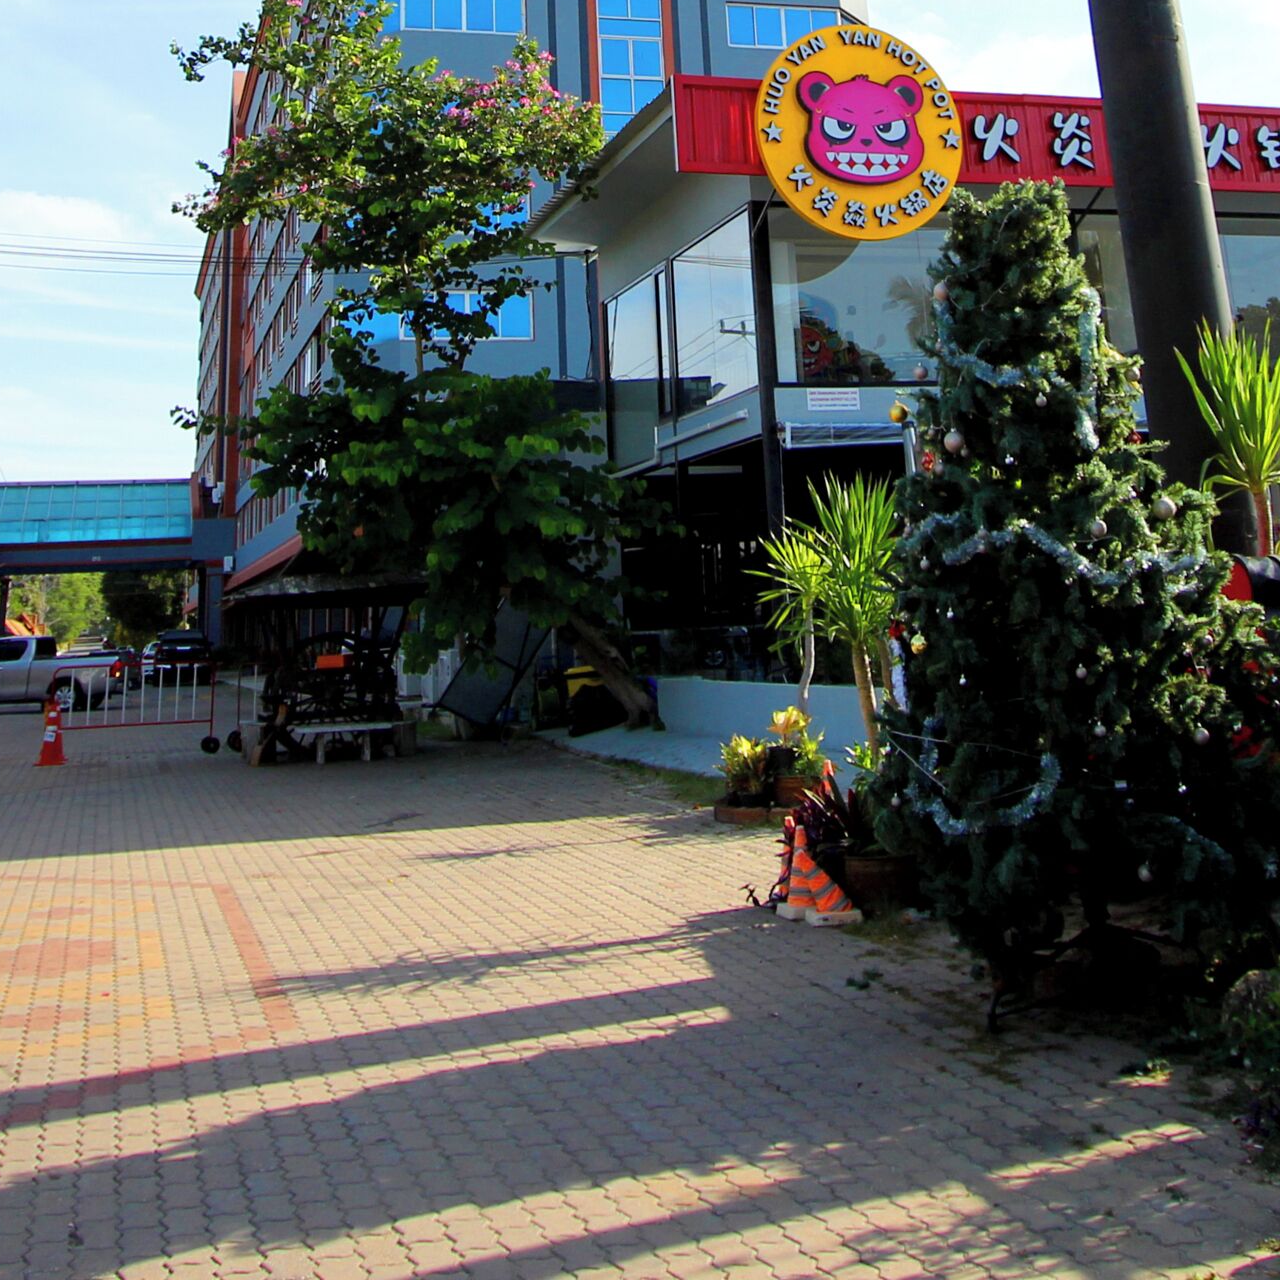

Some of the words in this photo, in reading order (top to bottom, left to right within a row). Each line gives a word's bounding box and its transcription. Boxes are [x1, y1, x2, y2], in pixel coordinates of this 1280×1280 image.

[764, 67, 791, 115] HUO
[786, 35, 827, 67] YAN
[838, 29, 881, 49] YAN
[885, 41, 929, 75] HOT
[924, 78, 955, 120] POT
